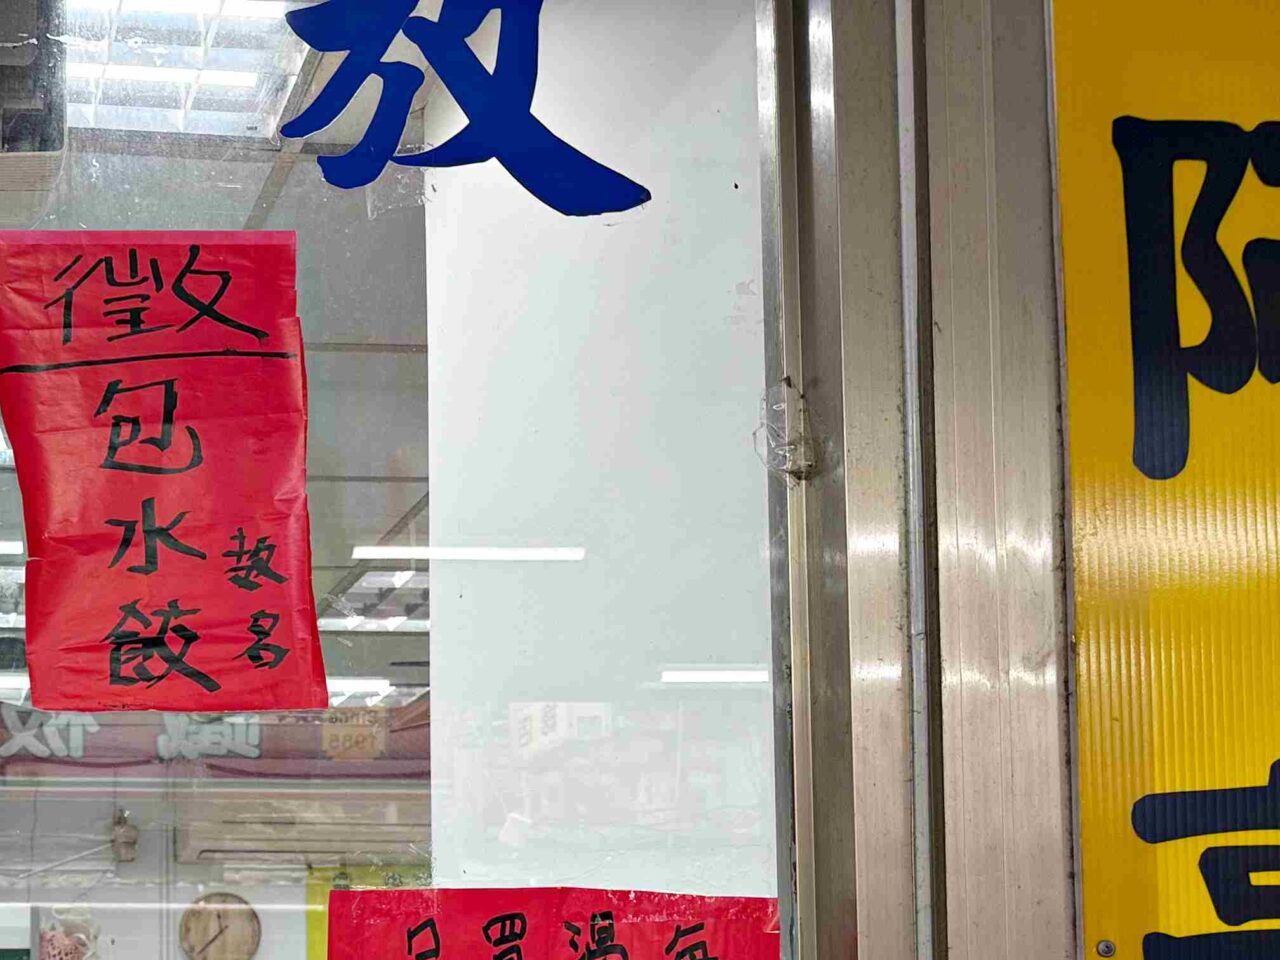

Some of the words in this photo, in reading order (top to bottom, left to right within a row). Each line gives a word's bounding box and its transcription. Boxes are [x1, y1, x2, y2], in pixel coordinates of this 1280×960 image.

[44, 245, 269, 344] 徵
[95, 379, 222, 693] 包水餃
